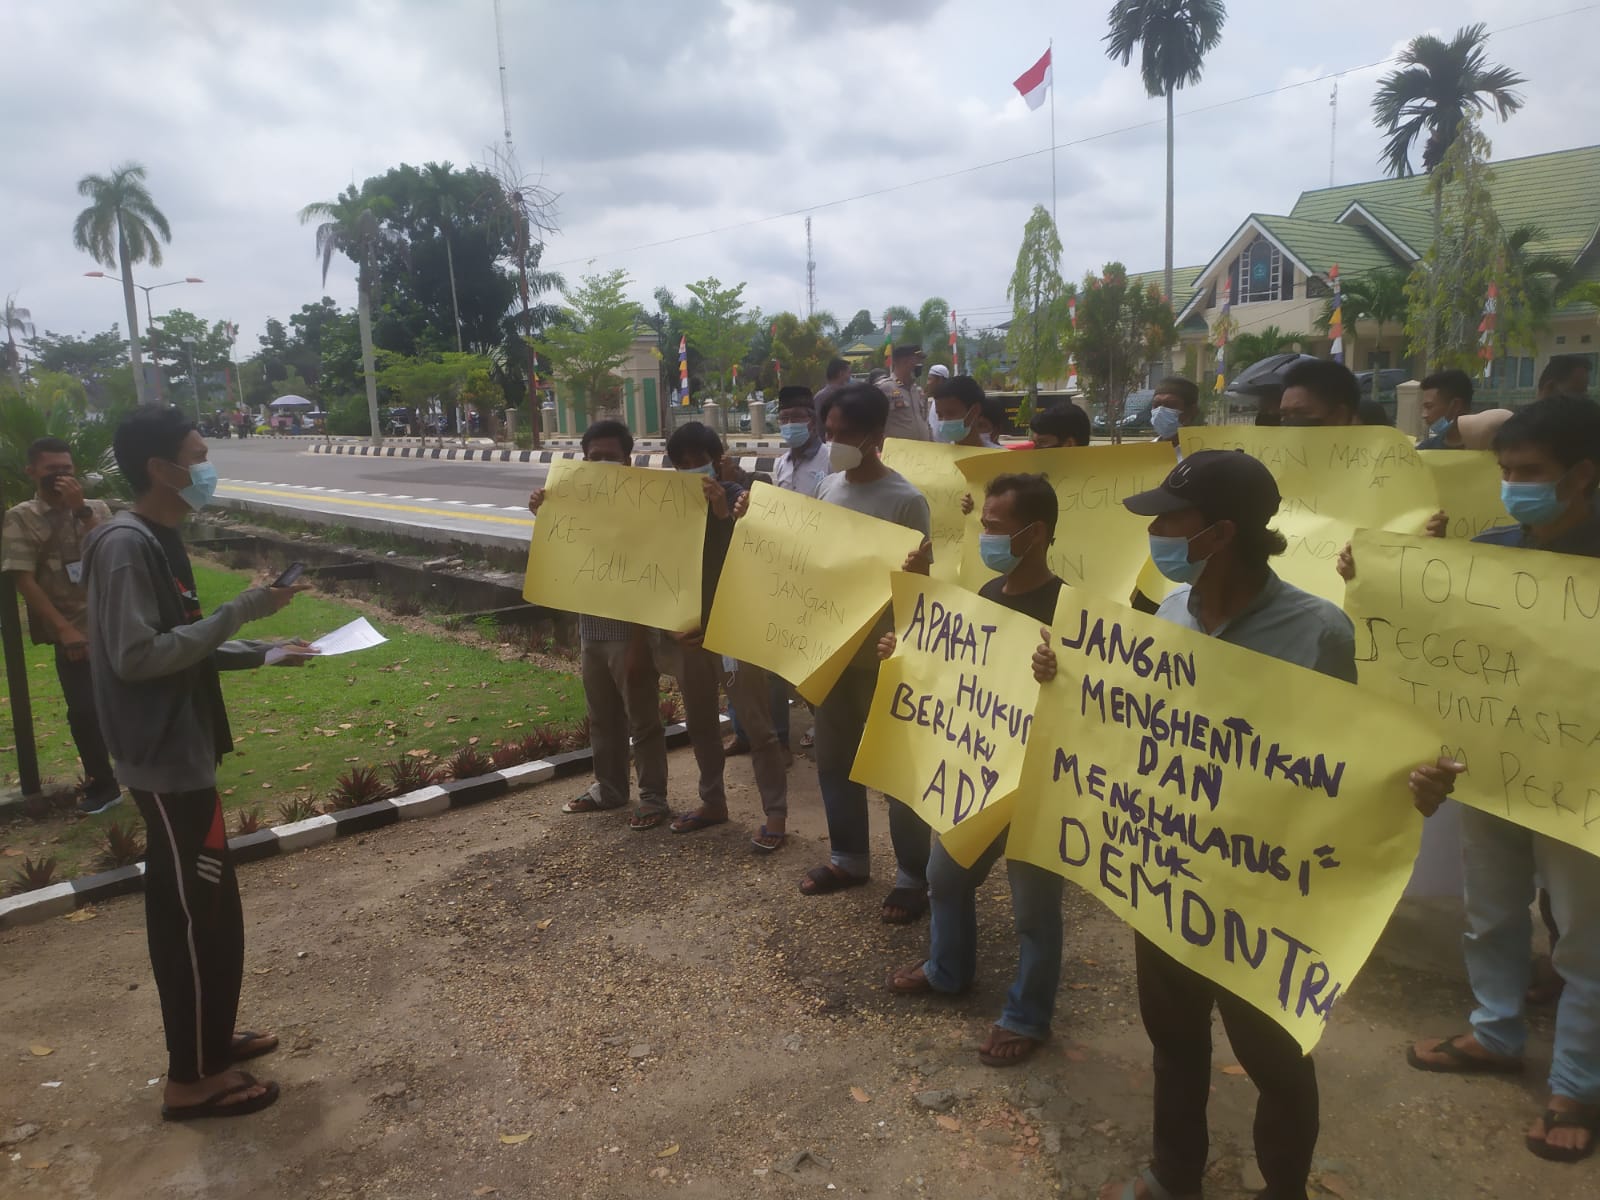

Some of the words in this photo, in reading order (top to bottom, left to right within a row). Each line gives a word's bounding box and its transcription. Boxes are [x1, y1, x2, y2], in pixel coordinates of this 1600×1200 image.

[768, 571, 845, 625] JANGAN
[902, 592, 997, 667] APARAT
[1061, 608, 1196, 690] JANGAN
[889, 682, 997, 763] BERLAKU
[1080, 673, 1346, 798] MENGHENTIKAN
[1138, 735, 1223, 812] DAN
[1103, 811, 1204, 884] UNTUK
